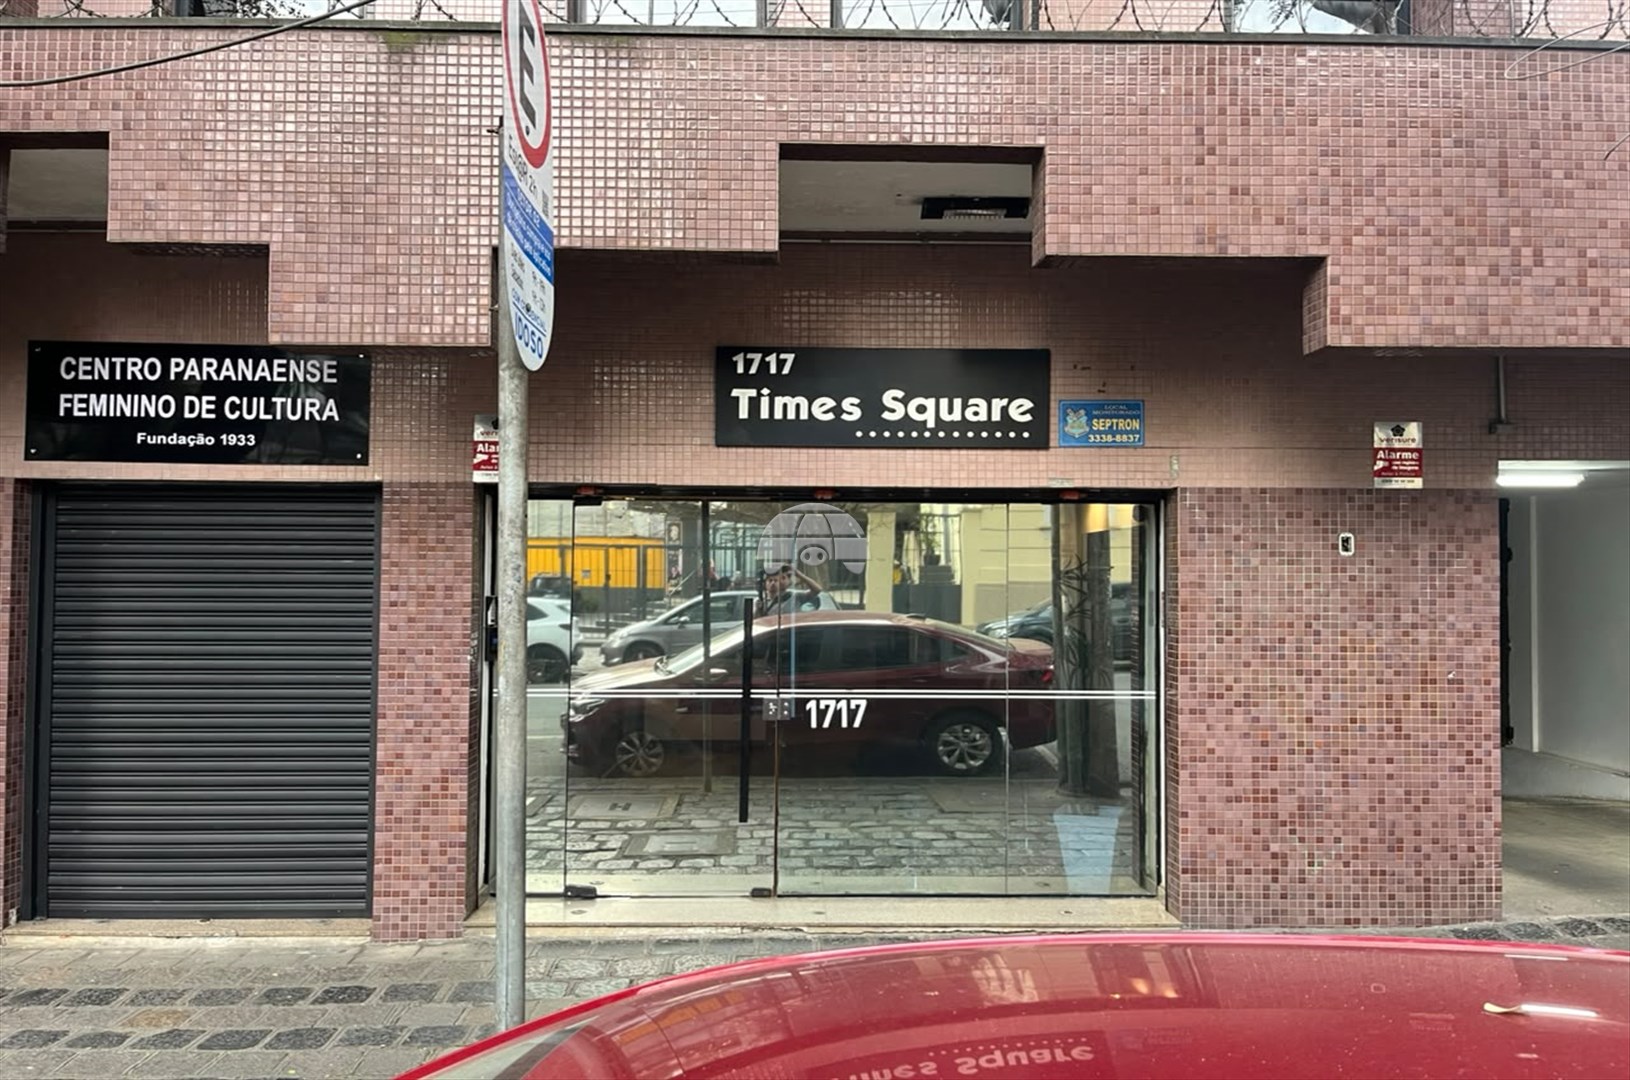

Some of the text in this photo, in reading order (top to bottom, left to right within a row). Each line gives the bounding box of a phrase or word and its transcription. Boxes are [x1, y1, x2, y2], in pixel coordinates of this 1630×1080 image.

[515, 312, 543, 359] IDOSO
[60, 356, 338, 383] CENTRO PARANAENSE
[732, 352, 796, 375] 1717
[58, 393, 340, 421] FEMININO DE CULTURA
[730, 387, 1035, 429] Times Square
[1092, 419, 1140, 430] SEPTRON
[136, 432, 256, 447] Fundação 1933
[1376, 450, 1420, 460] Alarme
[805, 699, 868, 729] 1717
